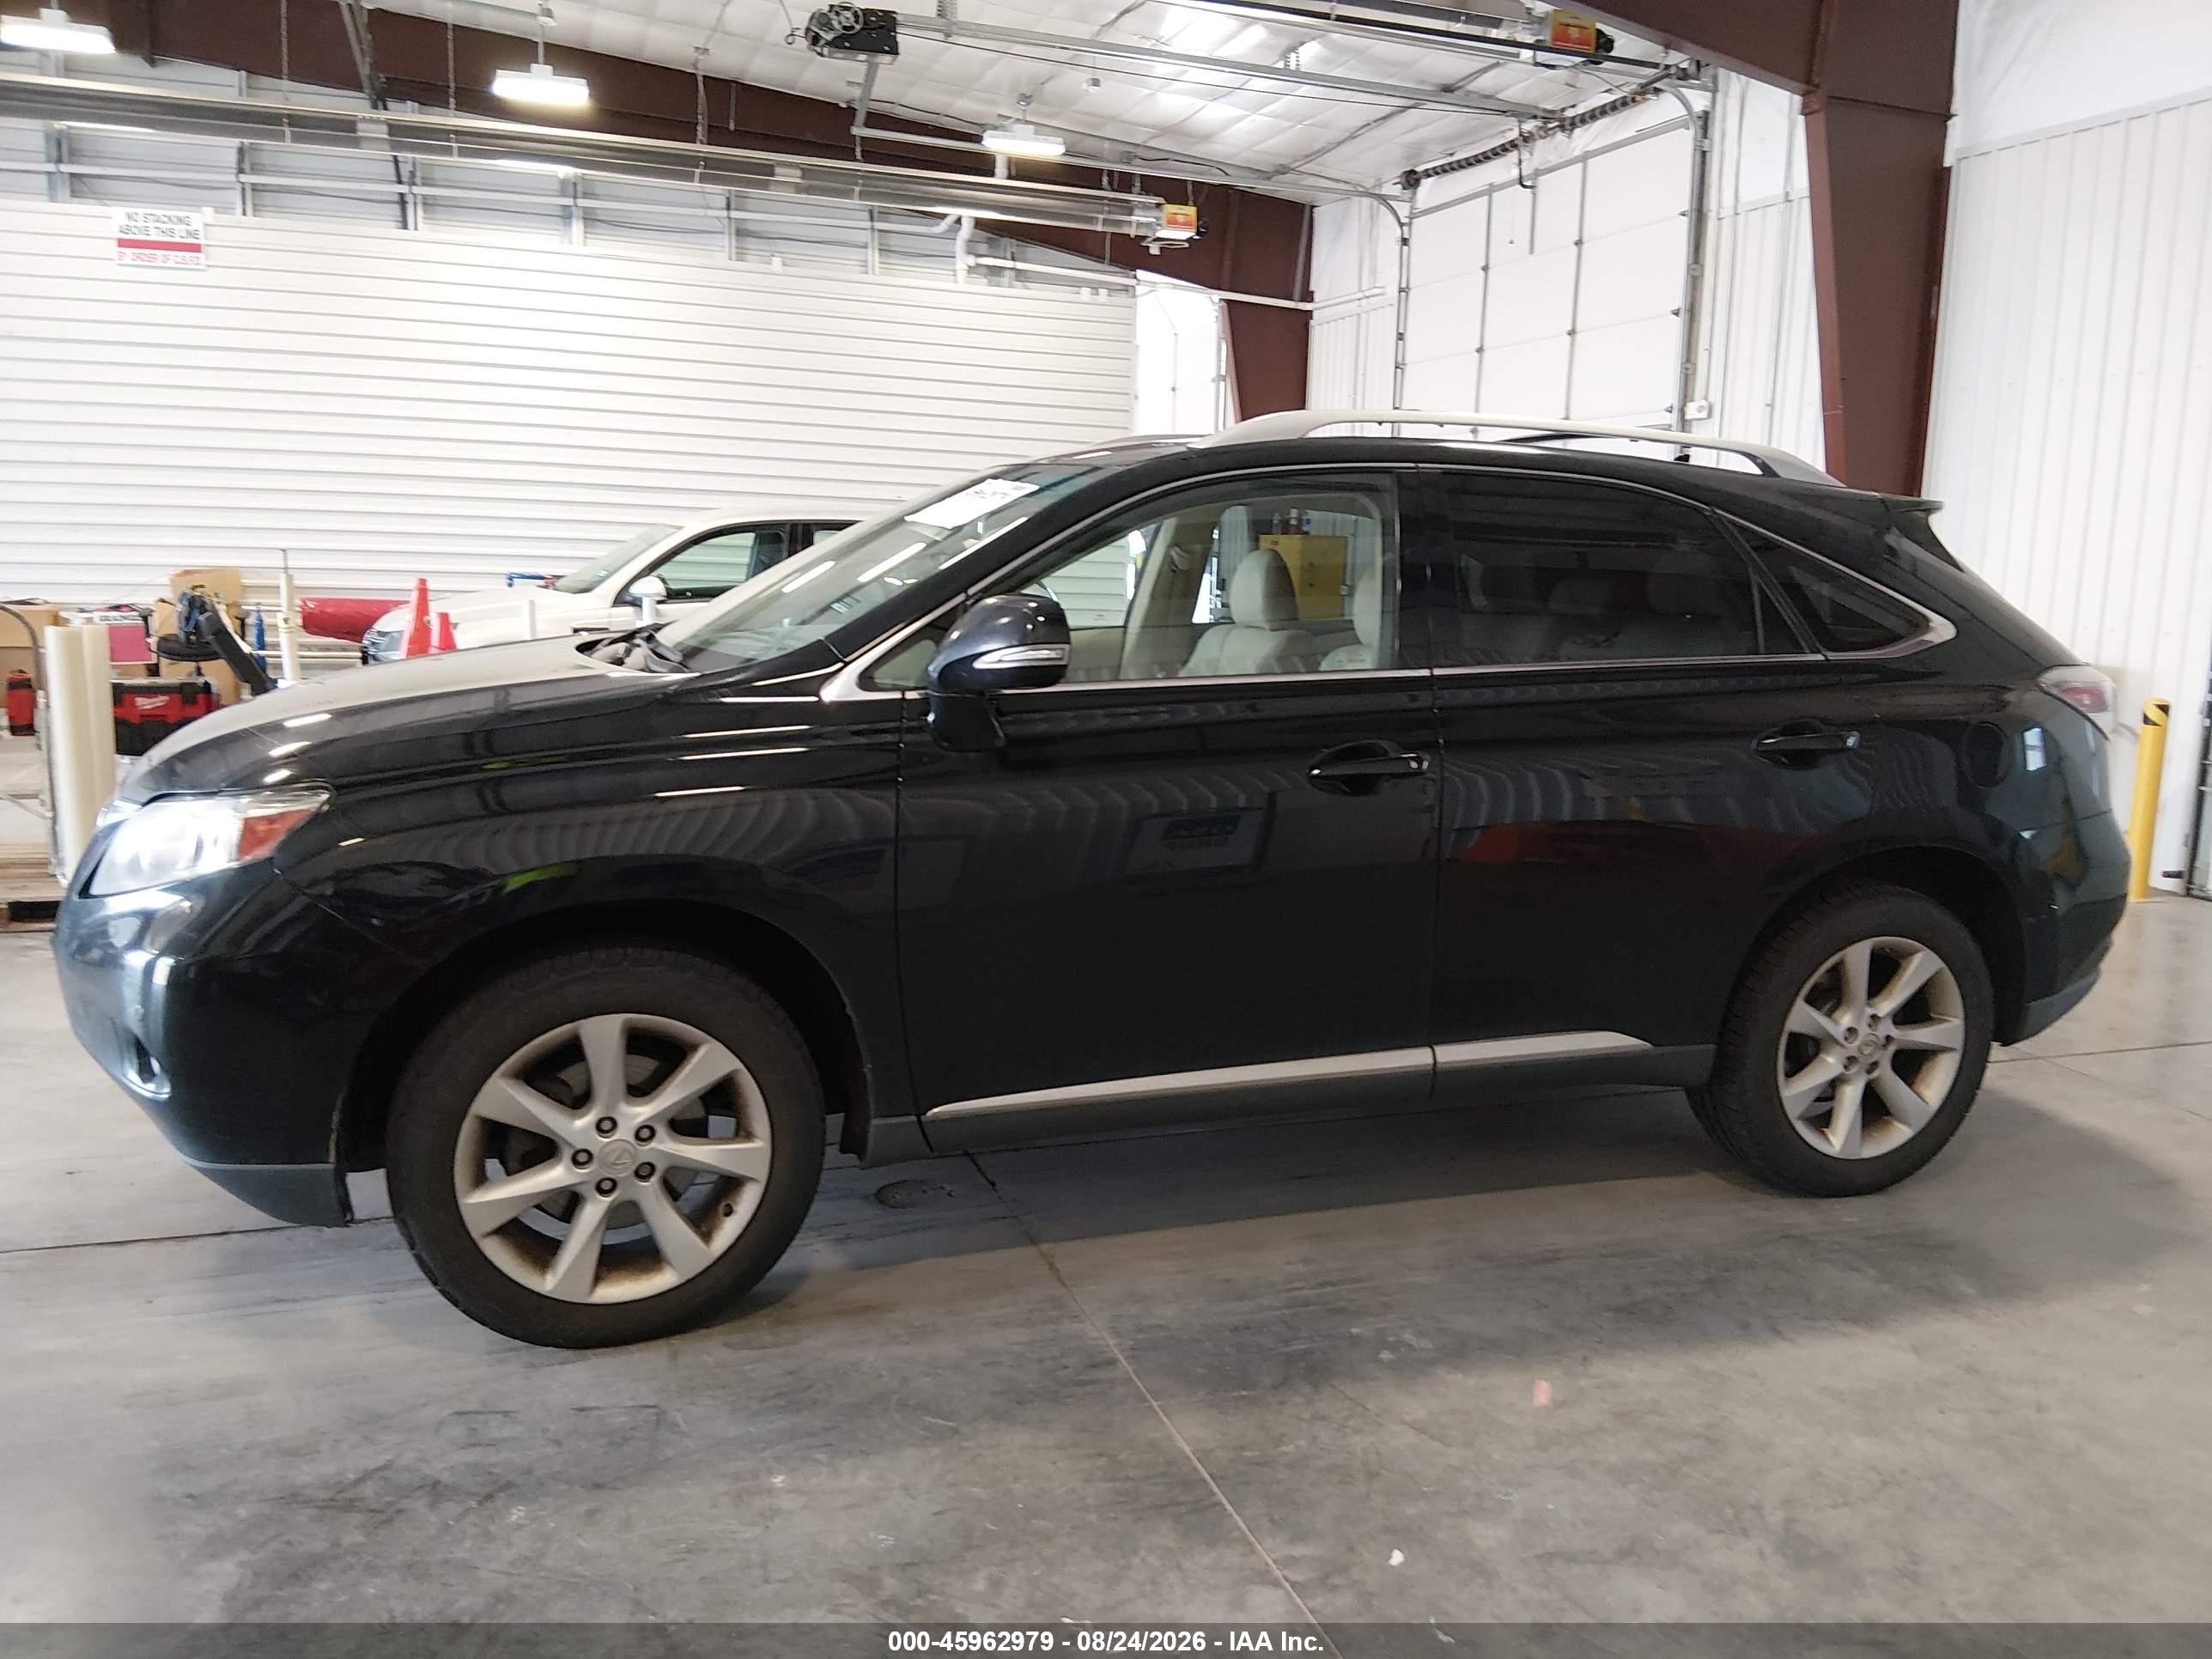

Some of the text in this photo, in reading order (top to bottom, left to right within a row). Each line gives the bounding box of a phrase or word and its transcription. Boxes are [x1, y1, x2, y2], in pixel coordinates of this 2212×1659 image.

[126, 212, 192, 226] NO STACKING
[118, 224, 201, 240] ABOVE THIS LINE
